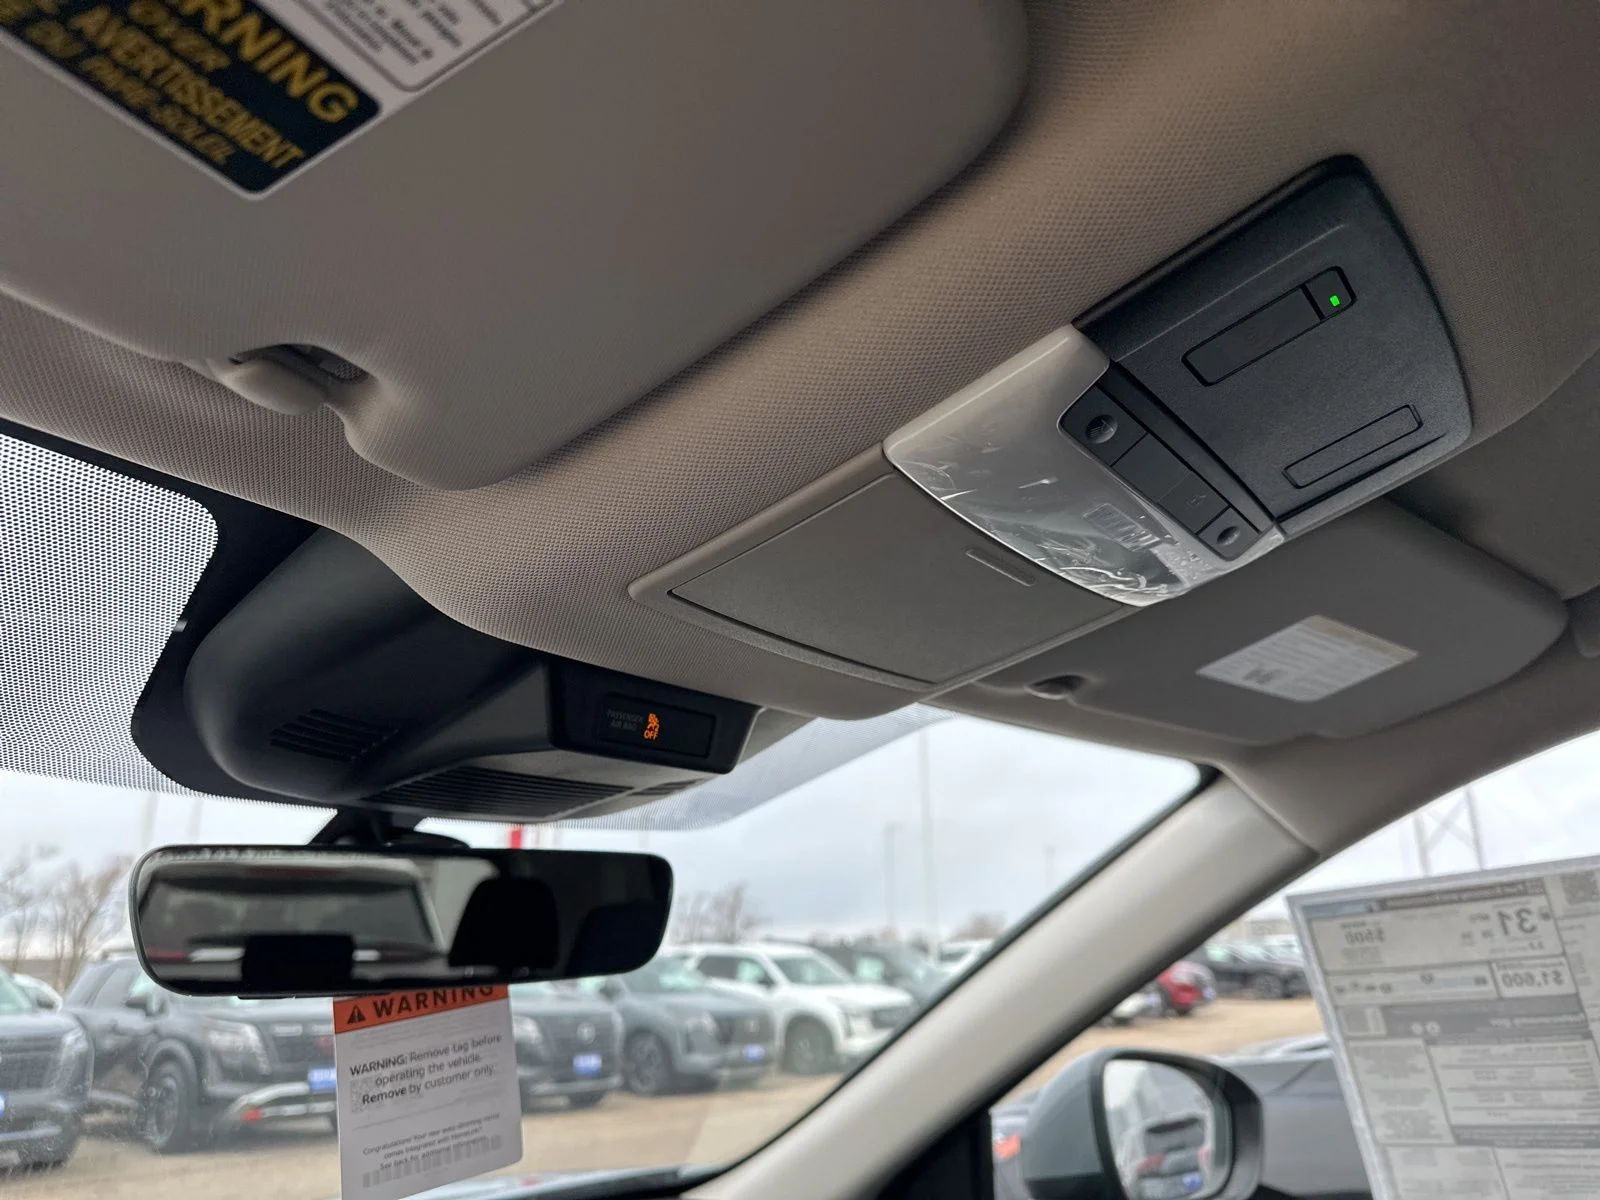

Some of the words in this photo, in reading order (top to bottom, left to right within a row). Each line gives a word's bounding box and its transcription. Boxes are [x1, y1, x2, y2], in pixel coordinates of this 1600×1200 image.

[69, 4, 306, 168] AVERTISSEMENT
[609, 720, 622, 729] AIR
[643, 730, 659, 740] OFF
[373, 986, 495, 1018] WARNING
[350, 1054, 408, 1076] WARNING:
[410, 1047, 449, 1063] Remove
[453, 1041, 469, 1053] tag
[471, 1034, 502, 1049] before
[362, 1086, 407, 1105] Remove
[409, 1082, 421, 1094] by
[425, 1070, 470, 1090] customer
[375, 1066, 425, 1087] operating
[427, 1062, 444, 1074] the
